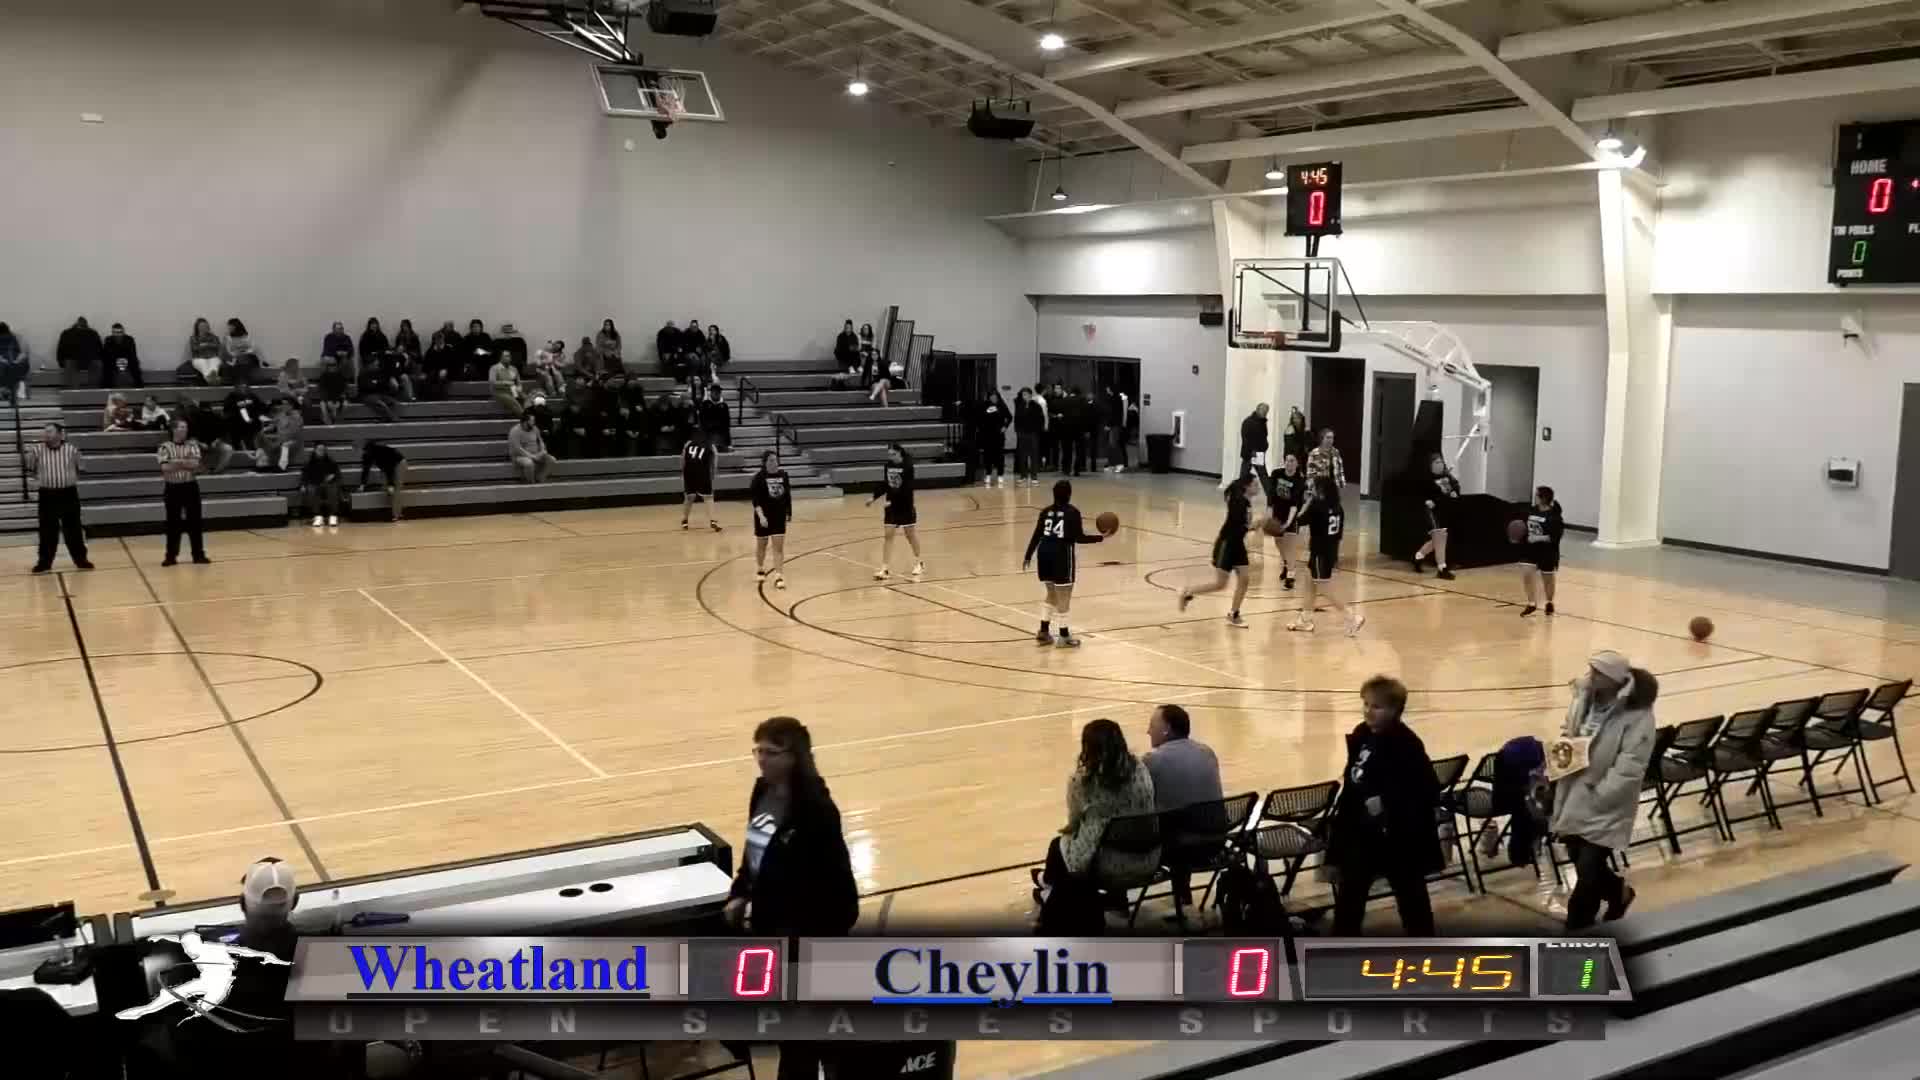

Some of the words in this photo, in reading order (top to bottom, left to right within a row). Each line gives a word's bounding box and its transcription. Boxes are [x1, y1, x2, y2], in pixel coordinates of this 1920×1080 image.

[1300, 167, 1328, 185] 4:45
[1850, 159, 1888, 175] HOME
[1869, 178, 1892, 213] 0
[1308, 190, 1325, 226] 0
[1852, 240, 1867, 264] 0
[689, 445, 705, 459] 41
[1043, 519, 1064, 538] 24
[1328, 515, 1340, 535] 21
